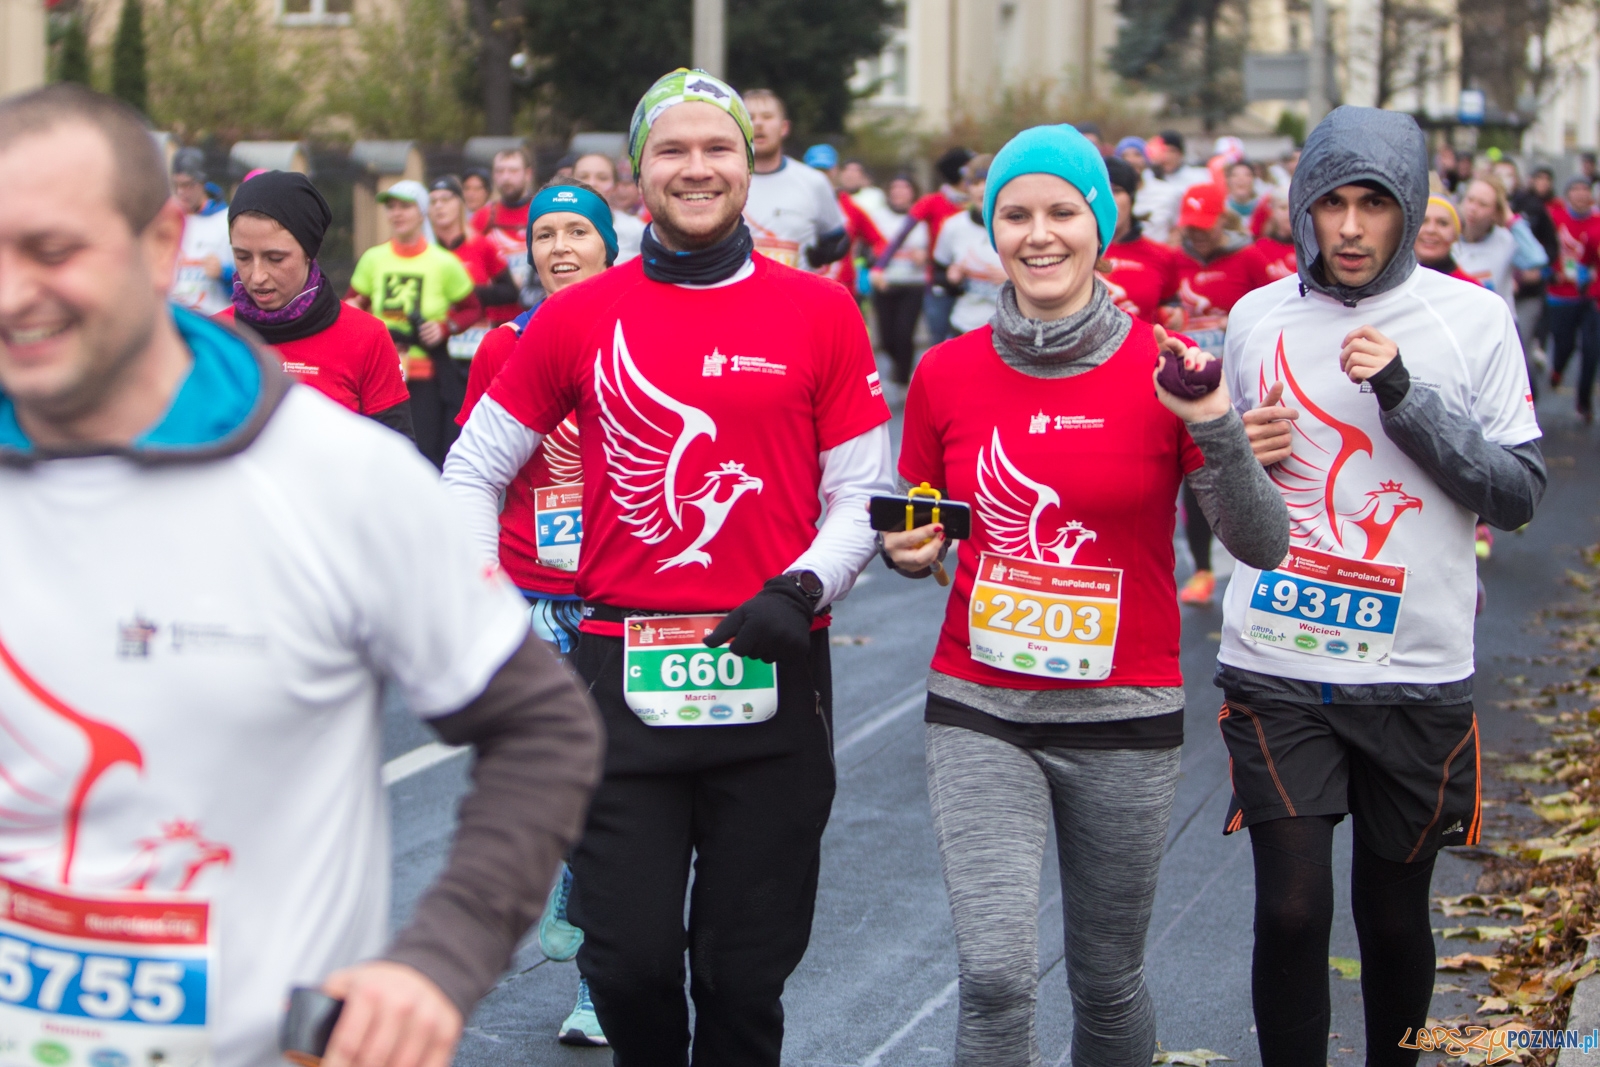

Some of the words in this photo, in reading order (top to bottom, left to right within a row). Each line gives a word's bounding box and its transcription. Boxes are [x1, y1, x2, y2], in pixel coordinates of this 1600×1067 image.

[541, 525, 549, 534] E
[1051, 577, 1111, 592] RunPoland.org
[1337, 568, 1396, 586] RunPoland.org
[1257, 583, 1269, 596] E
[1271, 579, 1383, 628] 9318
[974, 600, 985, 613] D
[987, 594, 1102, 641] 2203
[1250, 630, 1277, 641] LUXMED
[1251, 624, 1273, 635] GRUPA
[1299, 622, 1341, 637] Wojciech
[1027, 642, 1048, 652] Ewa
[629, 665, 642, 678] C
[660, 652, 744, 688] 660
[0, 936, 187, 1024] 5755
